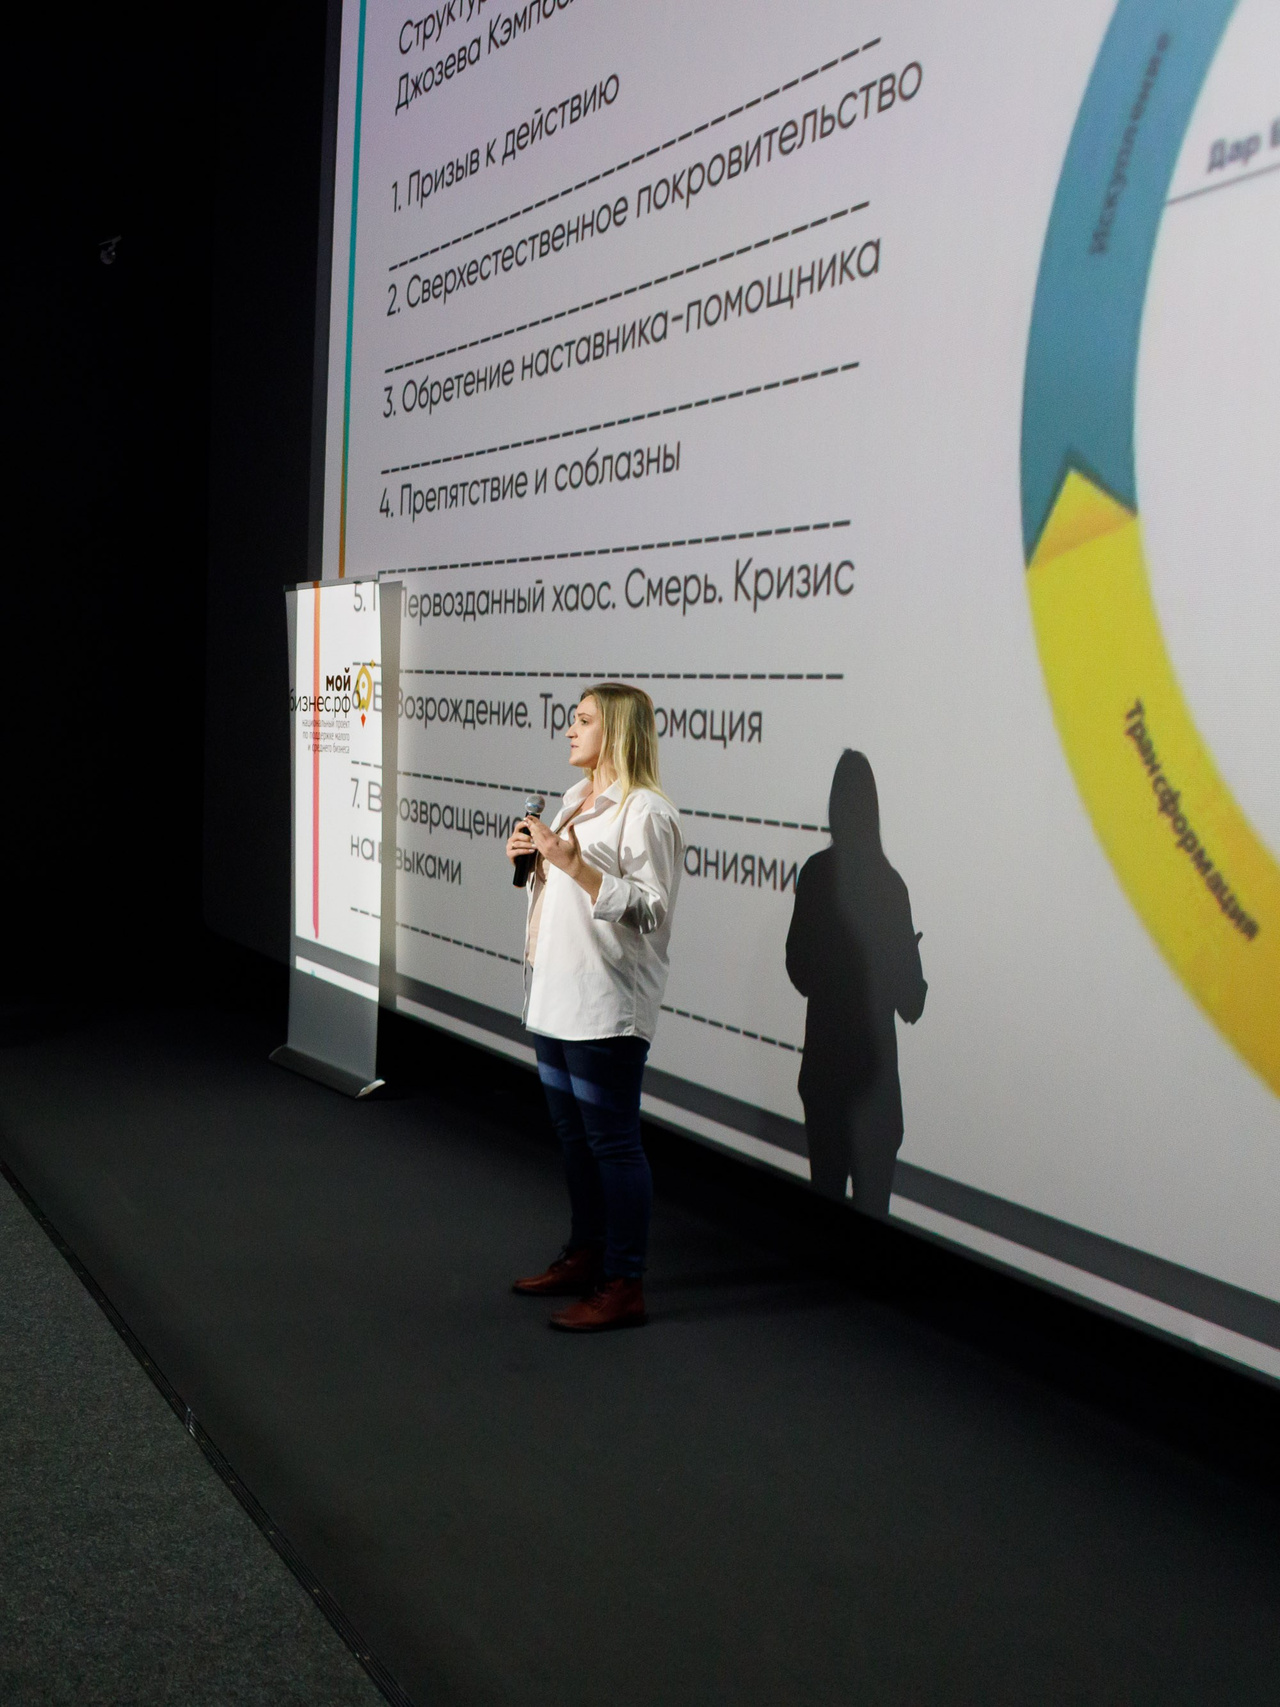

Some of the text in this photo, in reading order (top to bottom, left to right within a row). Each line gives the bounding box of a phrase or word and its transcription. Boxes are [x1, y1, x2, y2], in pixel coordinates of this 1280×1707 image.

[395, 35, 482, 116] Джозева
[391, 73, 620, 213] 1. Призыв к действию
[386, 60, 924, 317] 2. Сверхестественное покровительство
[383, 236, 882, 419] 3. Обретение наставника-помощника
[379, 441, 681, 522] 4. Препятствие и соблазны
[353, 582, 366, 613] 5.
[552, 582, 618, 613] хаос.
[625, 568, 724, 616] Смерь.
[734, 557, 855, 613] Кризис
[326, 667, 351, 691] мой
[350, 777, 361, 809] 7.
[1125, 699, 1260, 941] Трансформация
